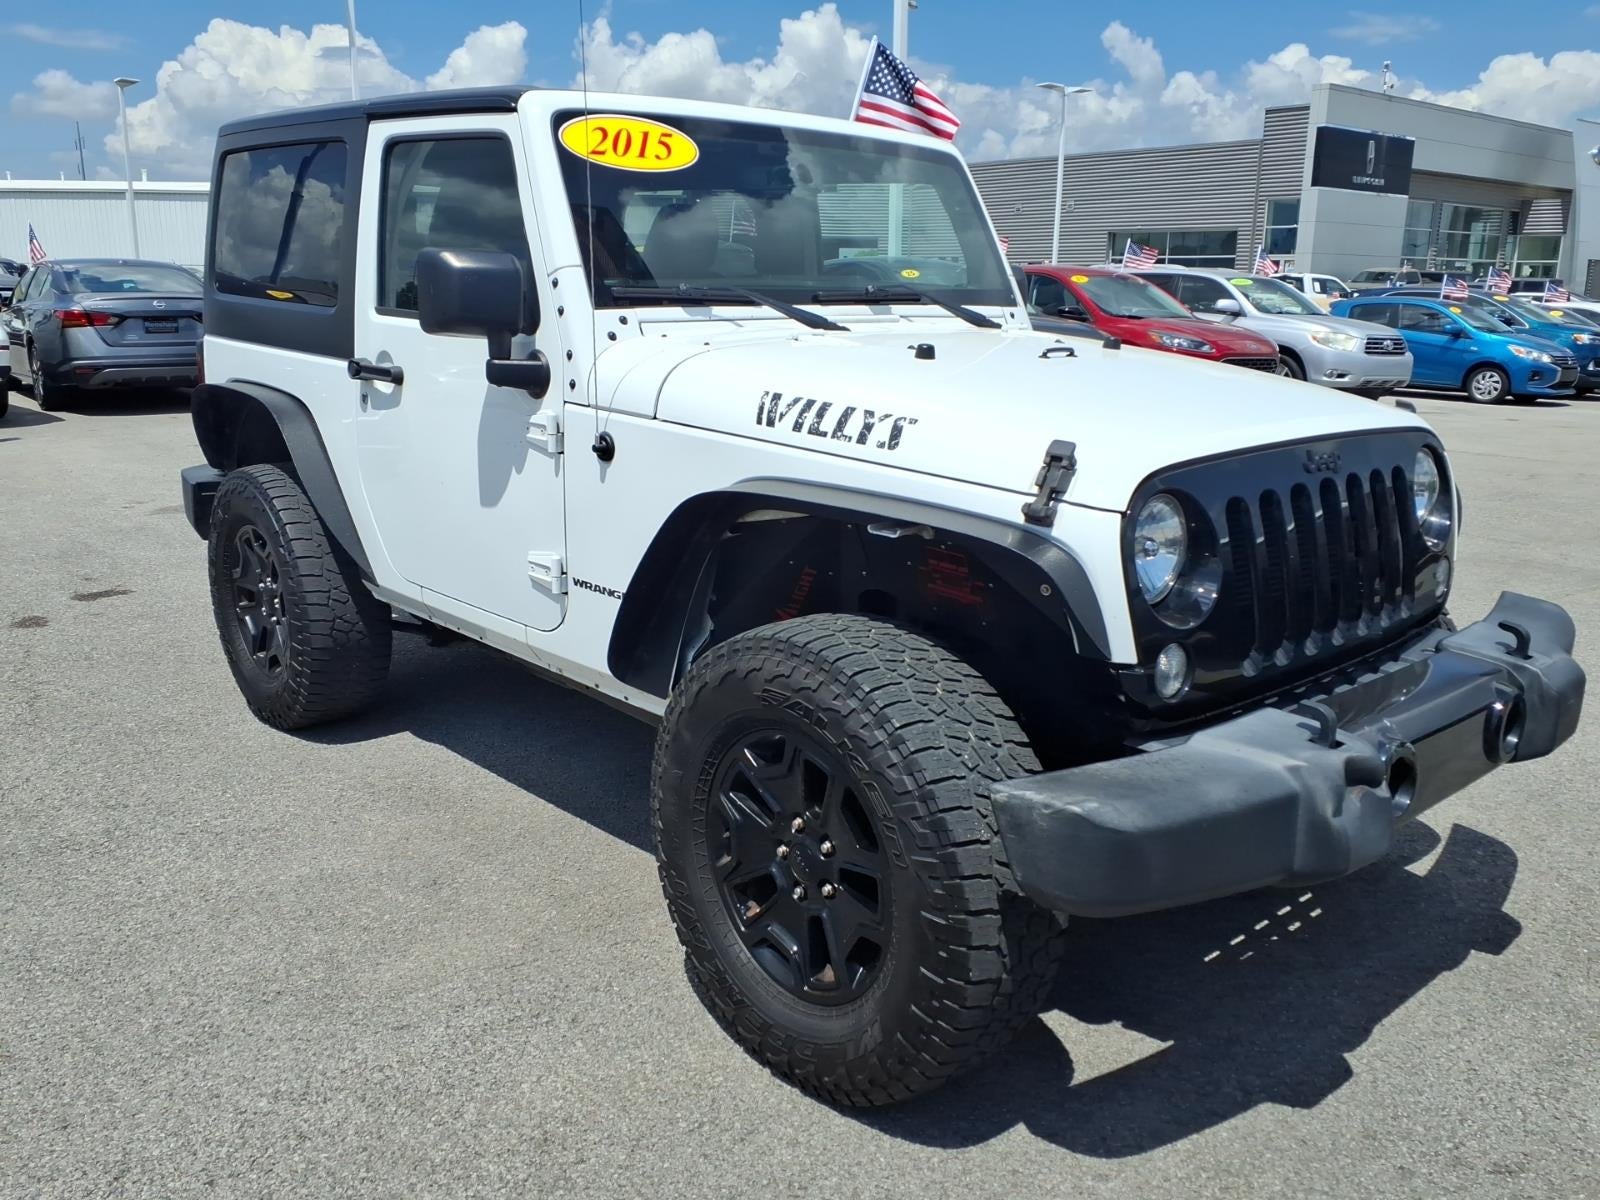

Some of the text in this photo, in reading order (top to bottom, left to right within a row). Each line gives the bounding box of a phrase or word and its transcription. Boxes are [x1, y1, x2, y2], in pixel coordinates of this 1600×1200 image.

[589, 126, 673, 161] 2015
[756, 390, 918, 451] WILLYS
[572, 577, 625, 600] WRANG
